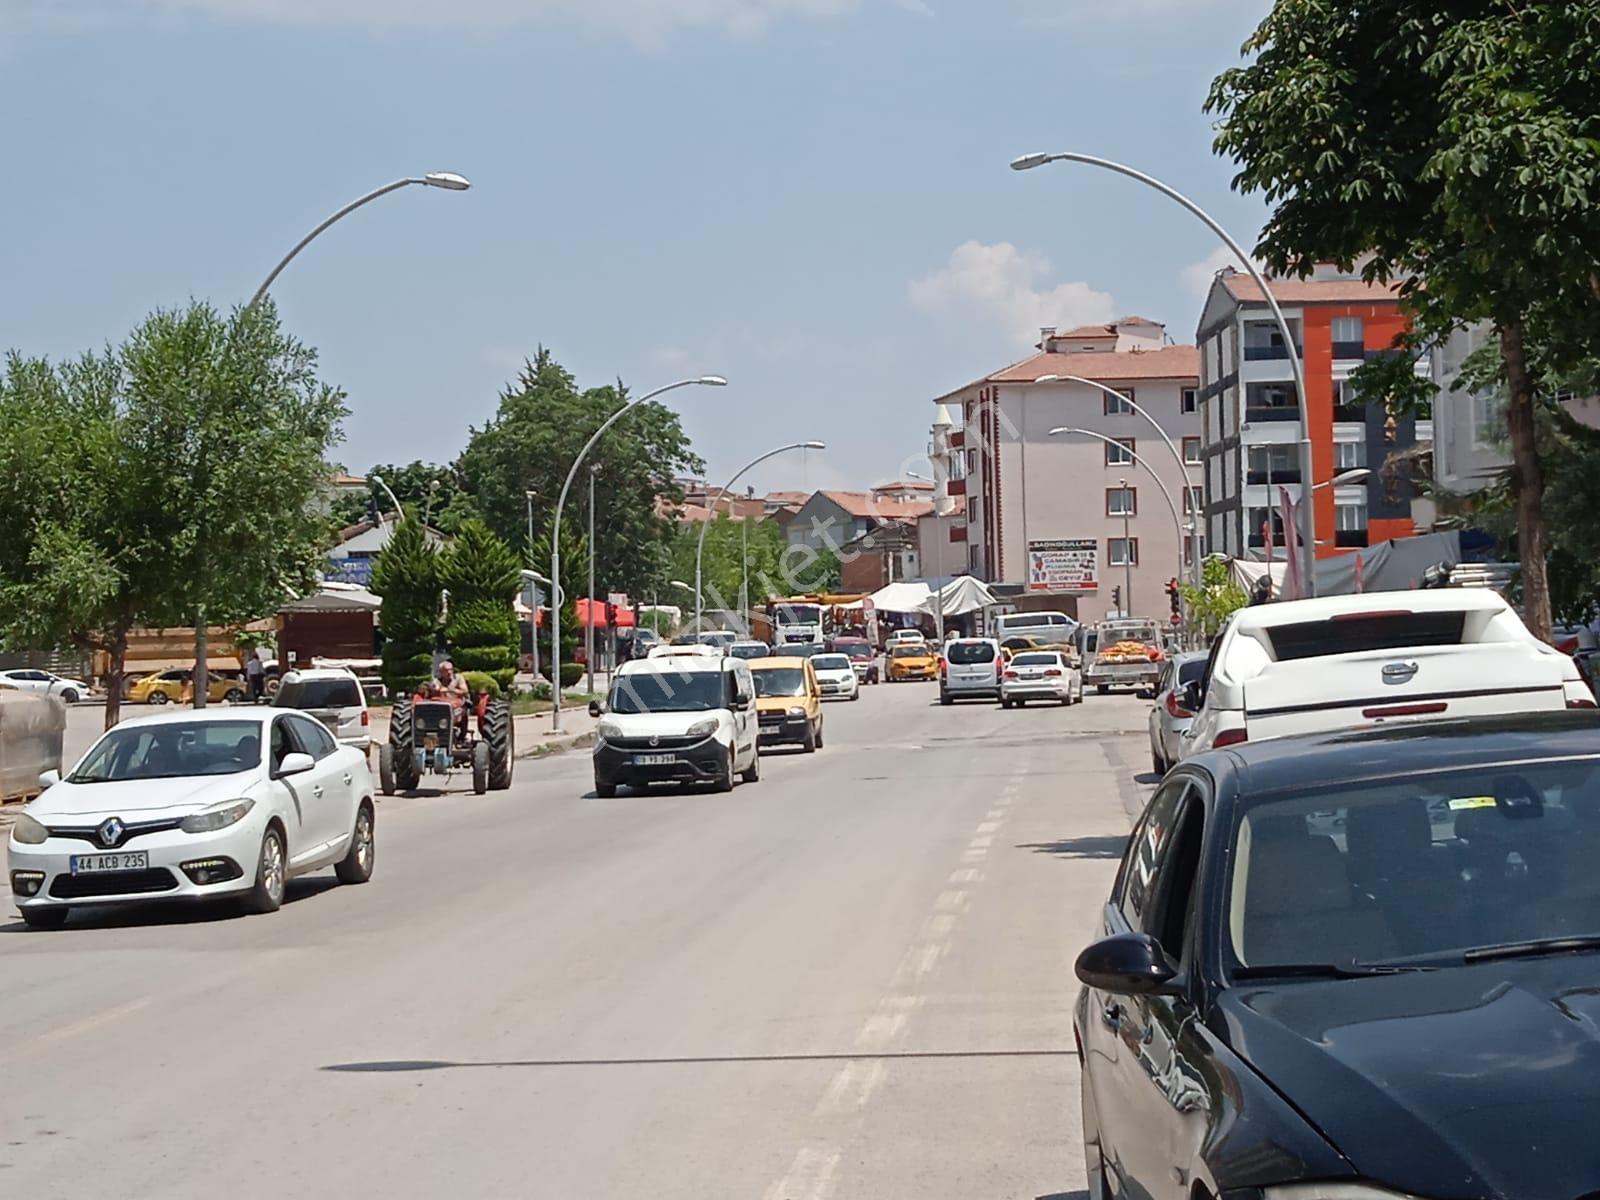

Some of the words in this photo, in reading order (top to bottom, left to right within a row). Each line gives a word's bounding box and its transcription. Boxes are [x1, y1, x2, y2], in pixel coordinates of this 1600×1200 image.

[79, 858, 92, 870] 44
[99, 856, 119, 869] ACB
[124, 854, 145, 868] 235
